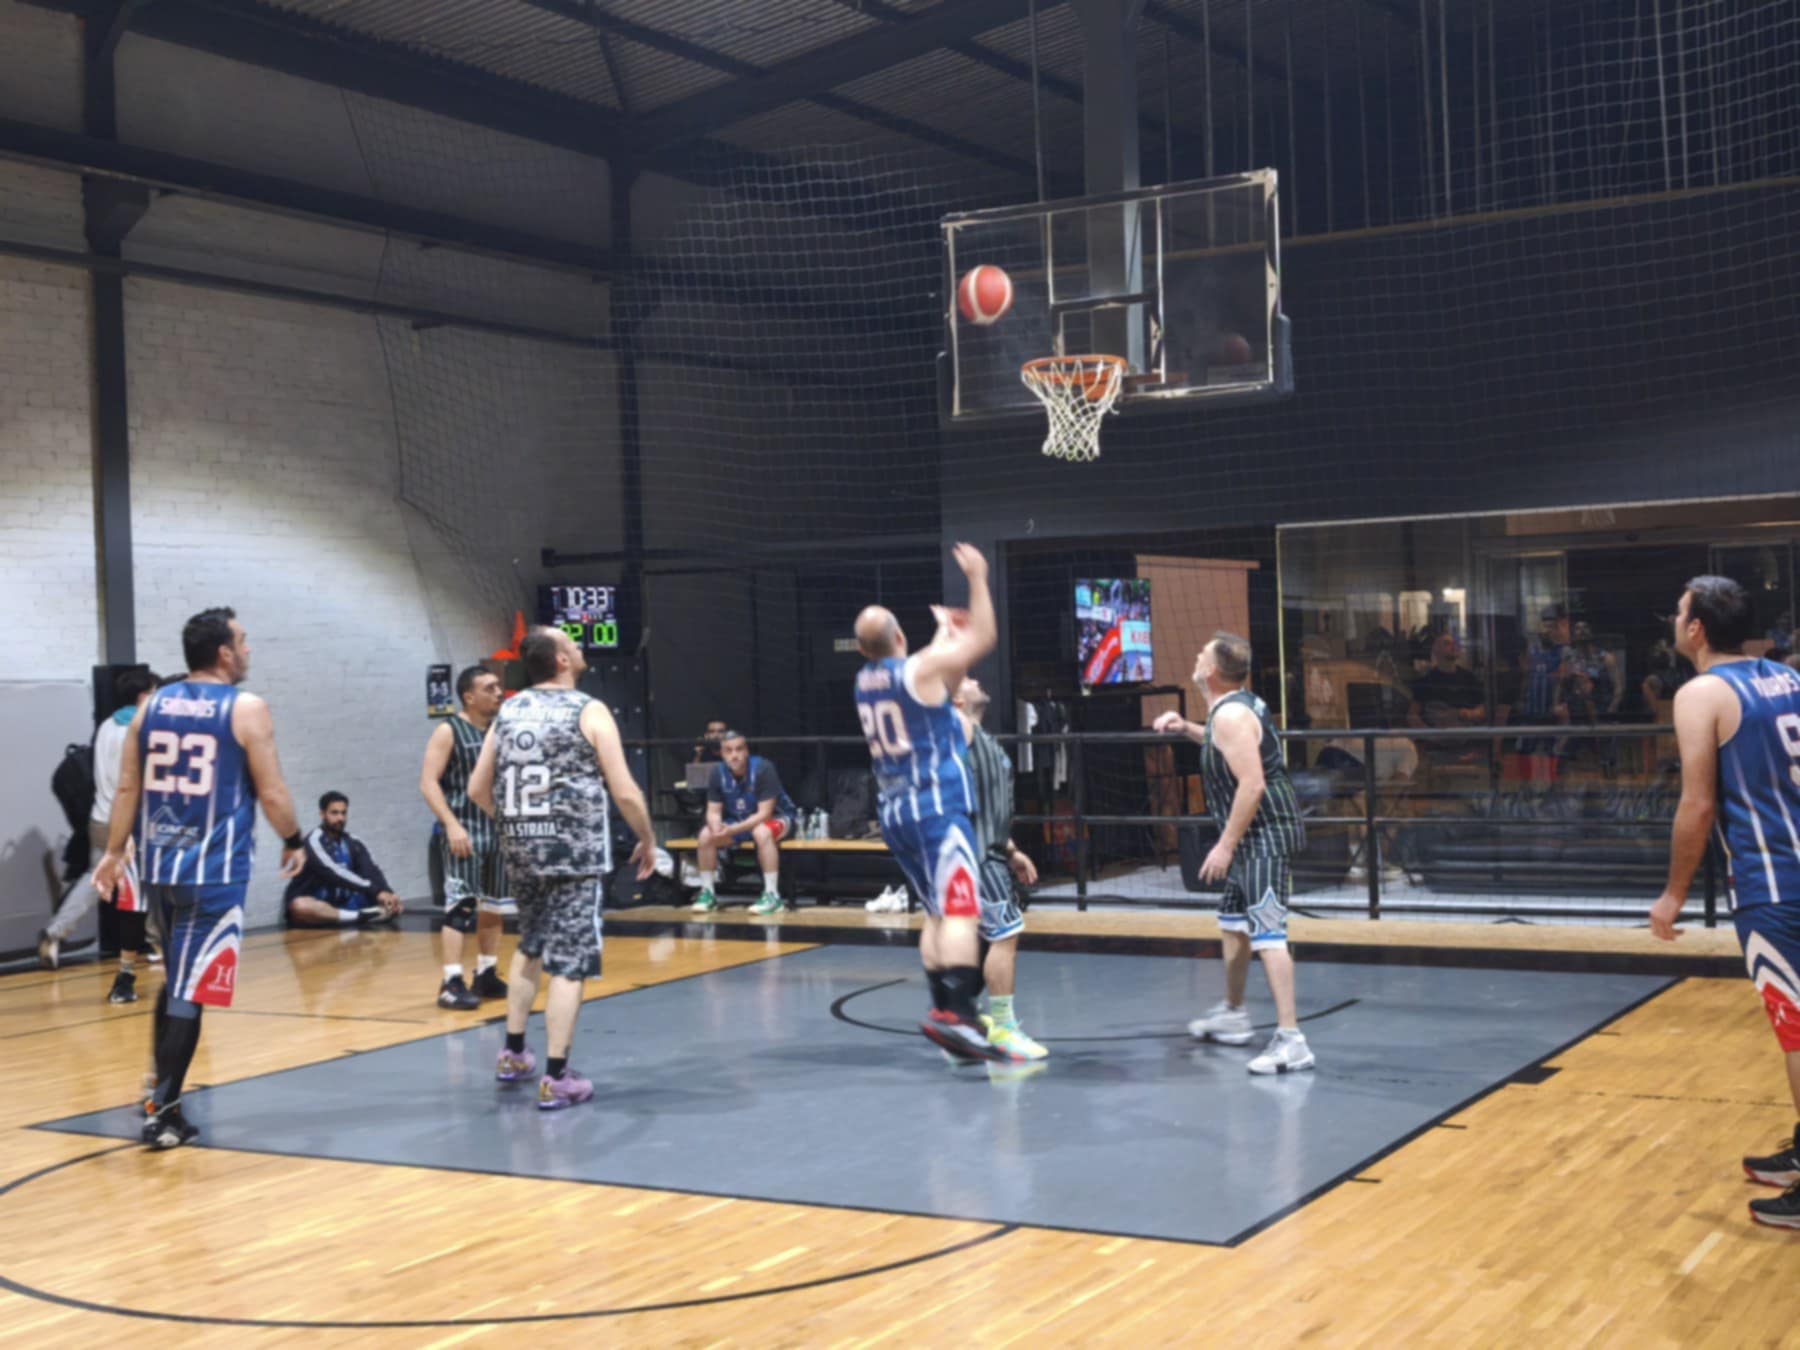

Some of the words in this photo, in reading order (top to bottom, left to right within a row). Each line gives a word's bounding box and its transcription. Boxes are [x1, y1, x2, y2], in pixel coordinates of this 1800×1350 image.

[565, 587, 608, 609] 10:33
[144, 731, 217, 796] 23
[503, 765, 550, 816] 12
[516, 821, 557, 837] STRATA
